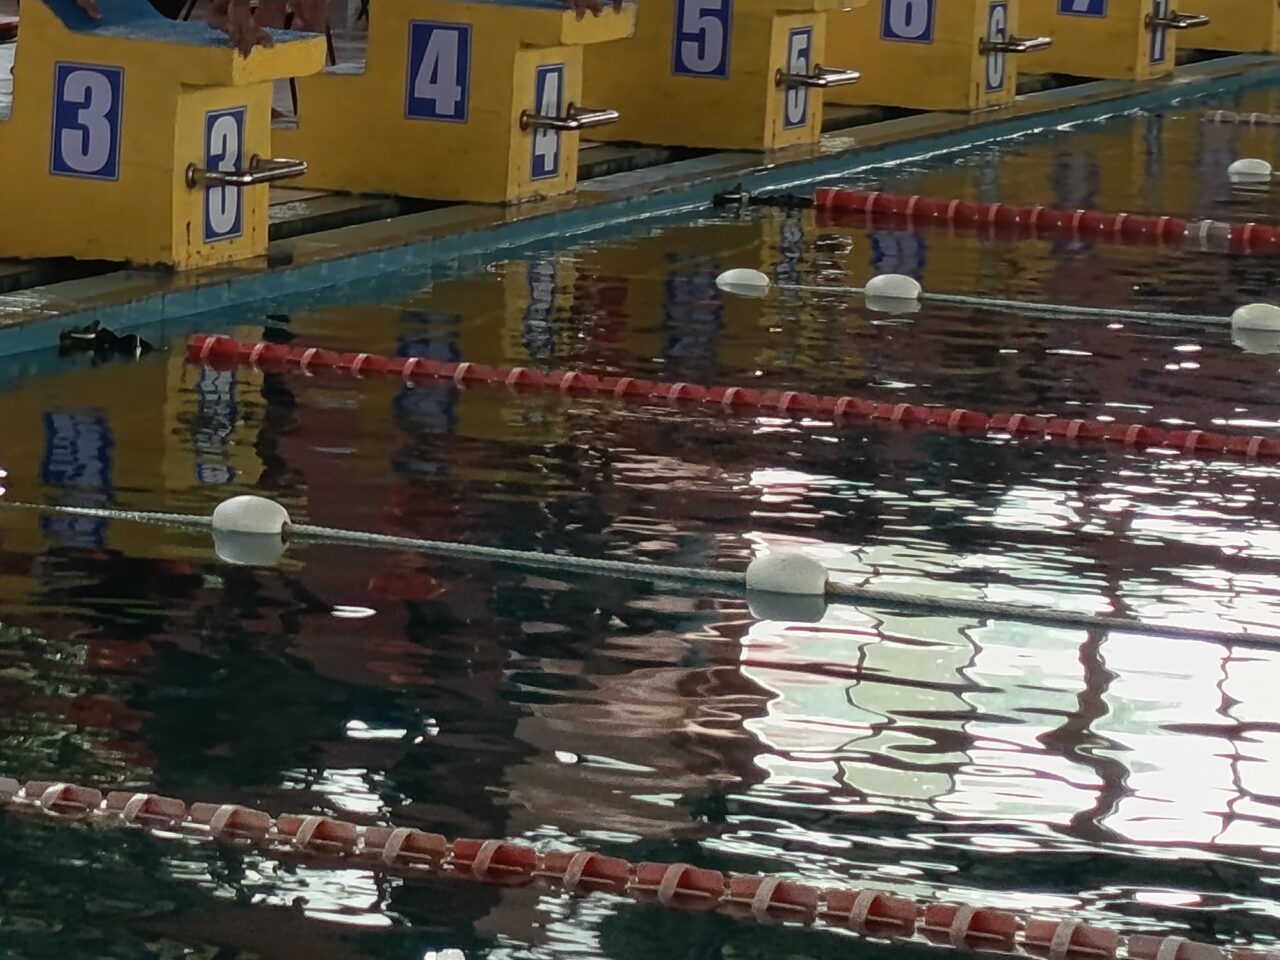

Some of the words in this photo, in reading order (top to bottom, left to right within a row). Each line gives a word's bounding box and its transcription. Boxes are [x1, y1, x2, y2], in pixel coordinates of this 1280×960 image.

[414, 29, 462, 115] 4
[787, 33, 808, 123] 5
[988, 6, 1005, 87] 6
[61, 70, 113, 172] 3
[535, 72, 559, 172] 4
[209, 116, 240, 234] 3
